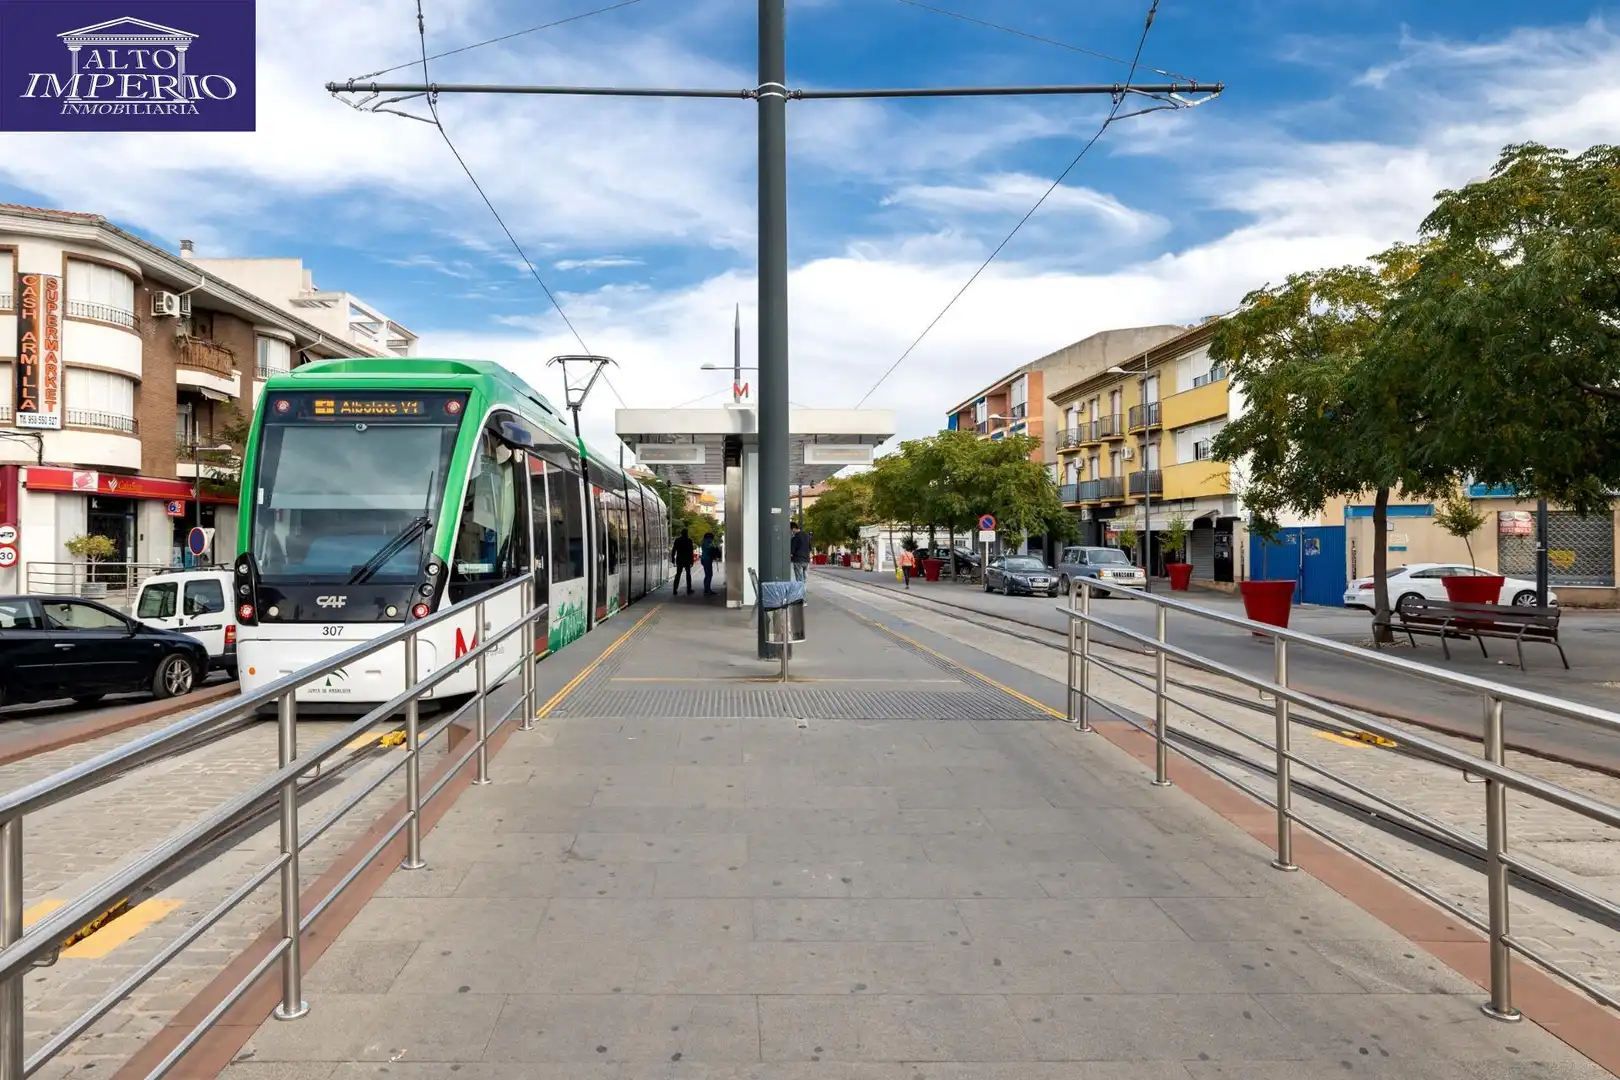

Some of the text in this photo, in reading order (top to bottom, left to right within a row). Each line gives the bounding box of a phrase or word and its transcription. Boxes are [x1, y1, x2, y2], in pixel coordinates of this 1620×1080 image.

[20, 275, 38, 411] CASH ARMILLA
[44, 278, 59, 413] SUPERMARKET
[733, 382, 749, 398] M
[0, 551, 14, 561] 30
[316, 595, 348, 608] CAF
[322, 626, 344, 636] 307
